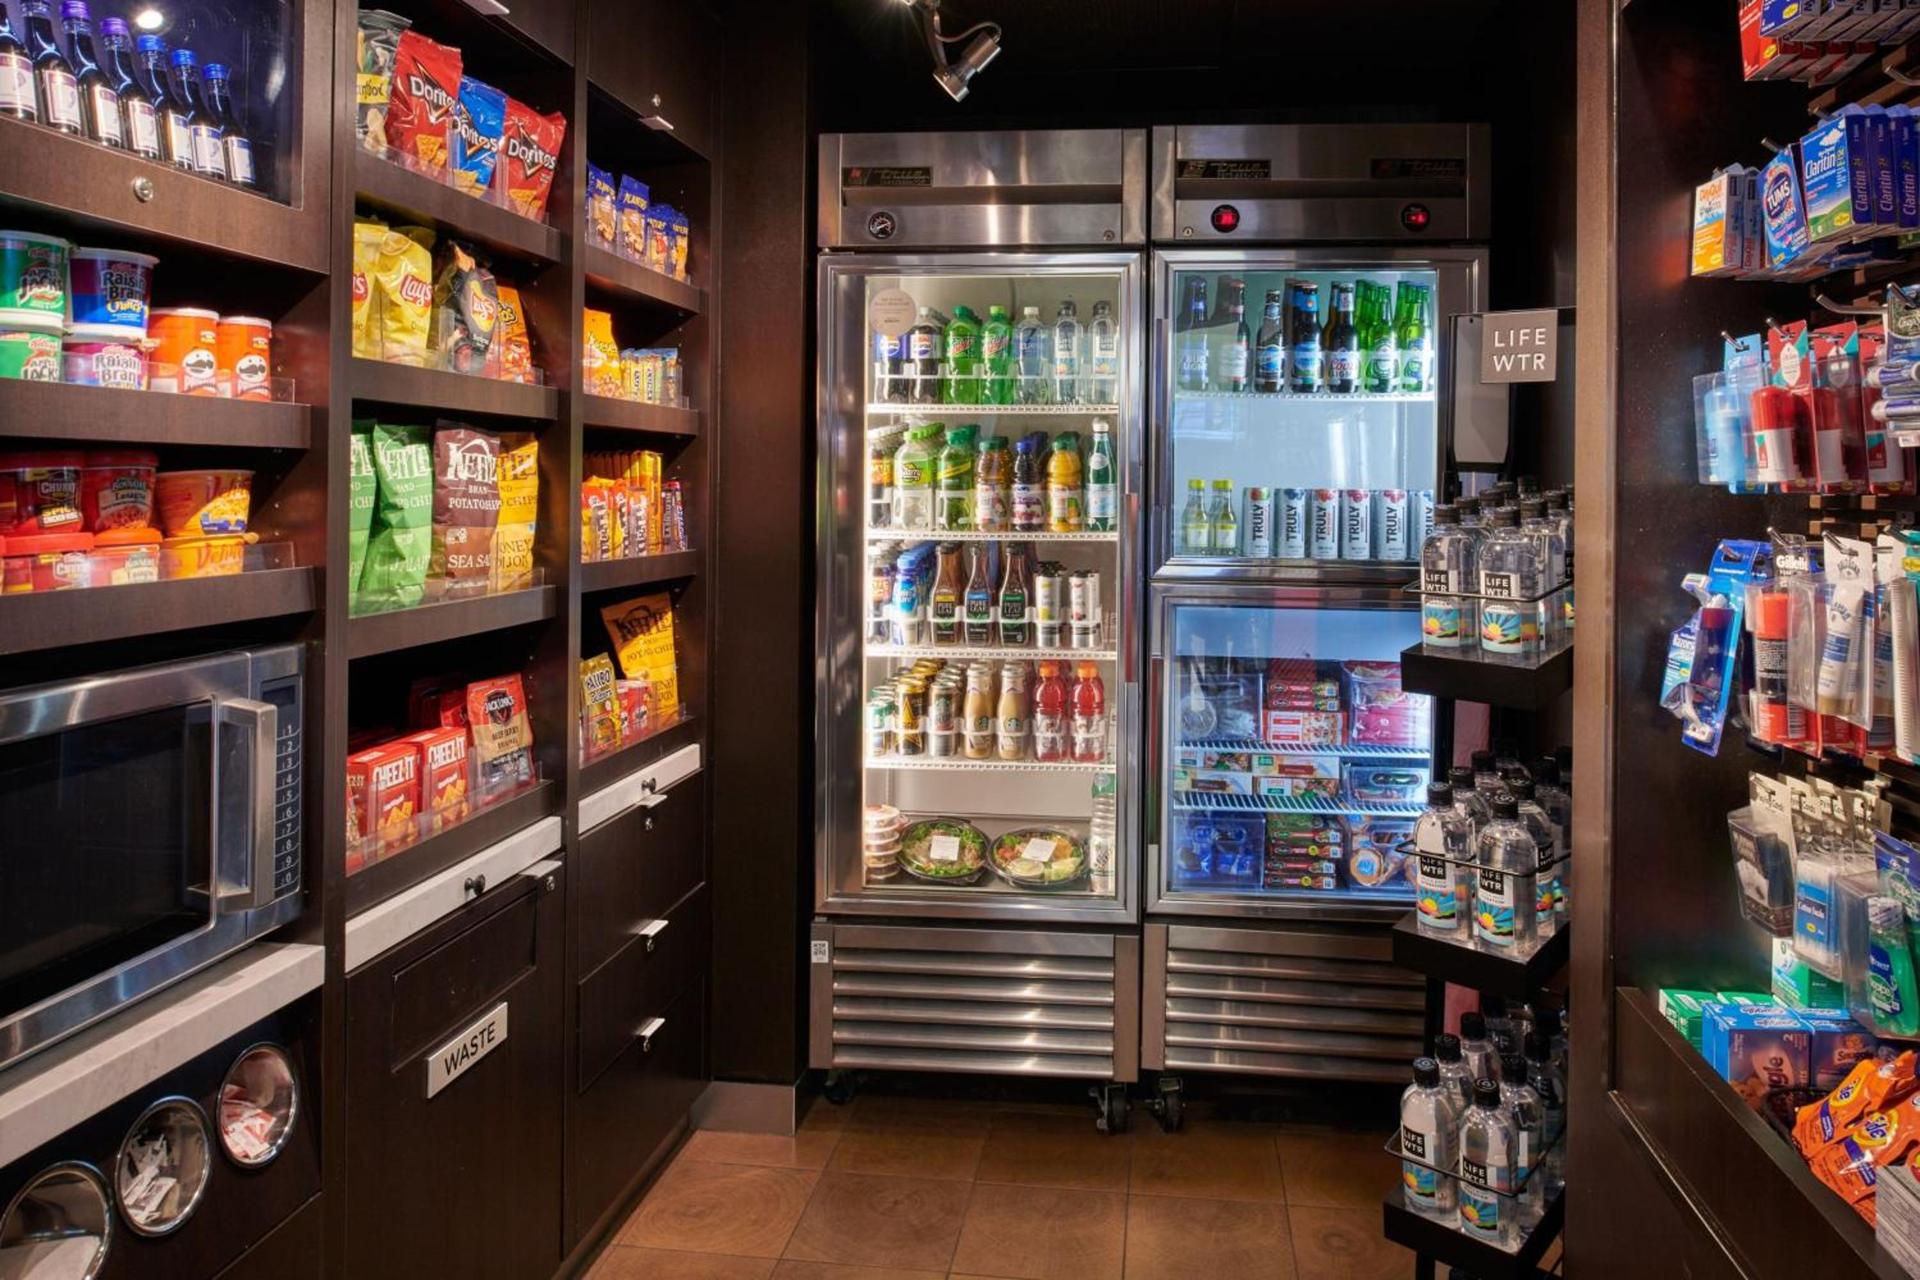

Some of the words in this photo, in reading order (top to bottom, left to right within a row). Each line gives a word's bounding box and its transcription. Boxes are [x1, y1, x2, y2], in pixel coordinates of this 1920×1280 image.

[508, 138, 556, 170] Doritos
[1806, 154, 1836, 180] Claritin
[1768, 182, 1791, 211] TUMS
[1856, 170, 1868, 211] Claritin
[1880, 170, 1893, 212] Claritin
[1904, 173, 1916, 215] Claritin
[1494, 327, 1547, 348] LIFE
[95, 353, 140, 372] Raisin
[1493, 353, 1547, 373] WTR
[100, 369, 137, 384] Bran
[444, 439, 500, 485] KETTL
[1252, 504, 1264, 541] TRULY
[1286, 504, 1298, 541] TRULY
[1316, 506, 1327, 542] TRULY
[1349, 506, 1360, 543] TRULY
[1385, 507, 1397, 544] TRULY
[448, 555, 474, 569] SEA
[476, 554, 493, 569] SA
[1425, 573, 1447, 584] LIFE
[1426, 583, 1447, 592] WTR
[1486, 577, 1509, 588] LIFE
[1487, 588, 1510, 598] WTR
[429, 735, 466, 771] CHEEZ-IT
[372, 754, 415, 791] CHEEZ-IT
[1422, 865, 1444, 876] WTR
[1480, 868, 1502, 880] LIFE
[1480, 879, 1502, 891] WTR
[444, 1020, 496, 1076] WASTE
[1403, 1130, 1423, 1145] LIFE
[1404, 1140, 1423, 1155] WTR
[1463, 1162, 1485, 1177] LIFE
